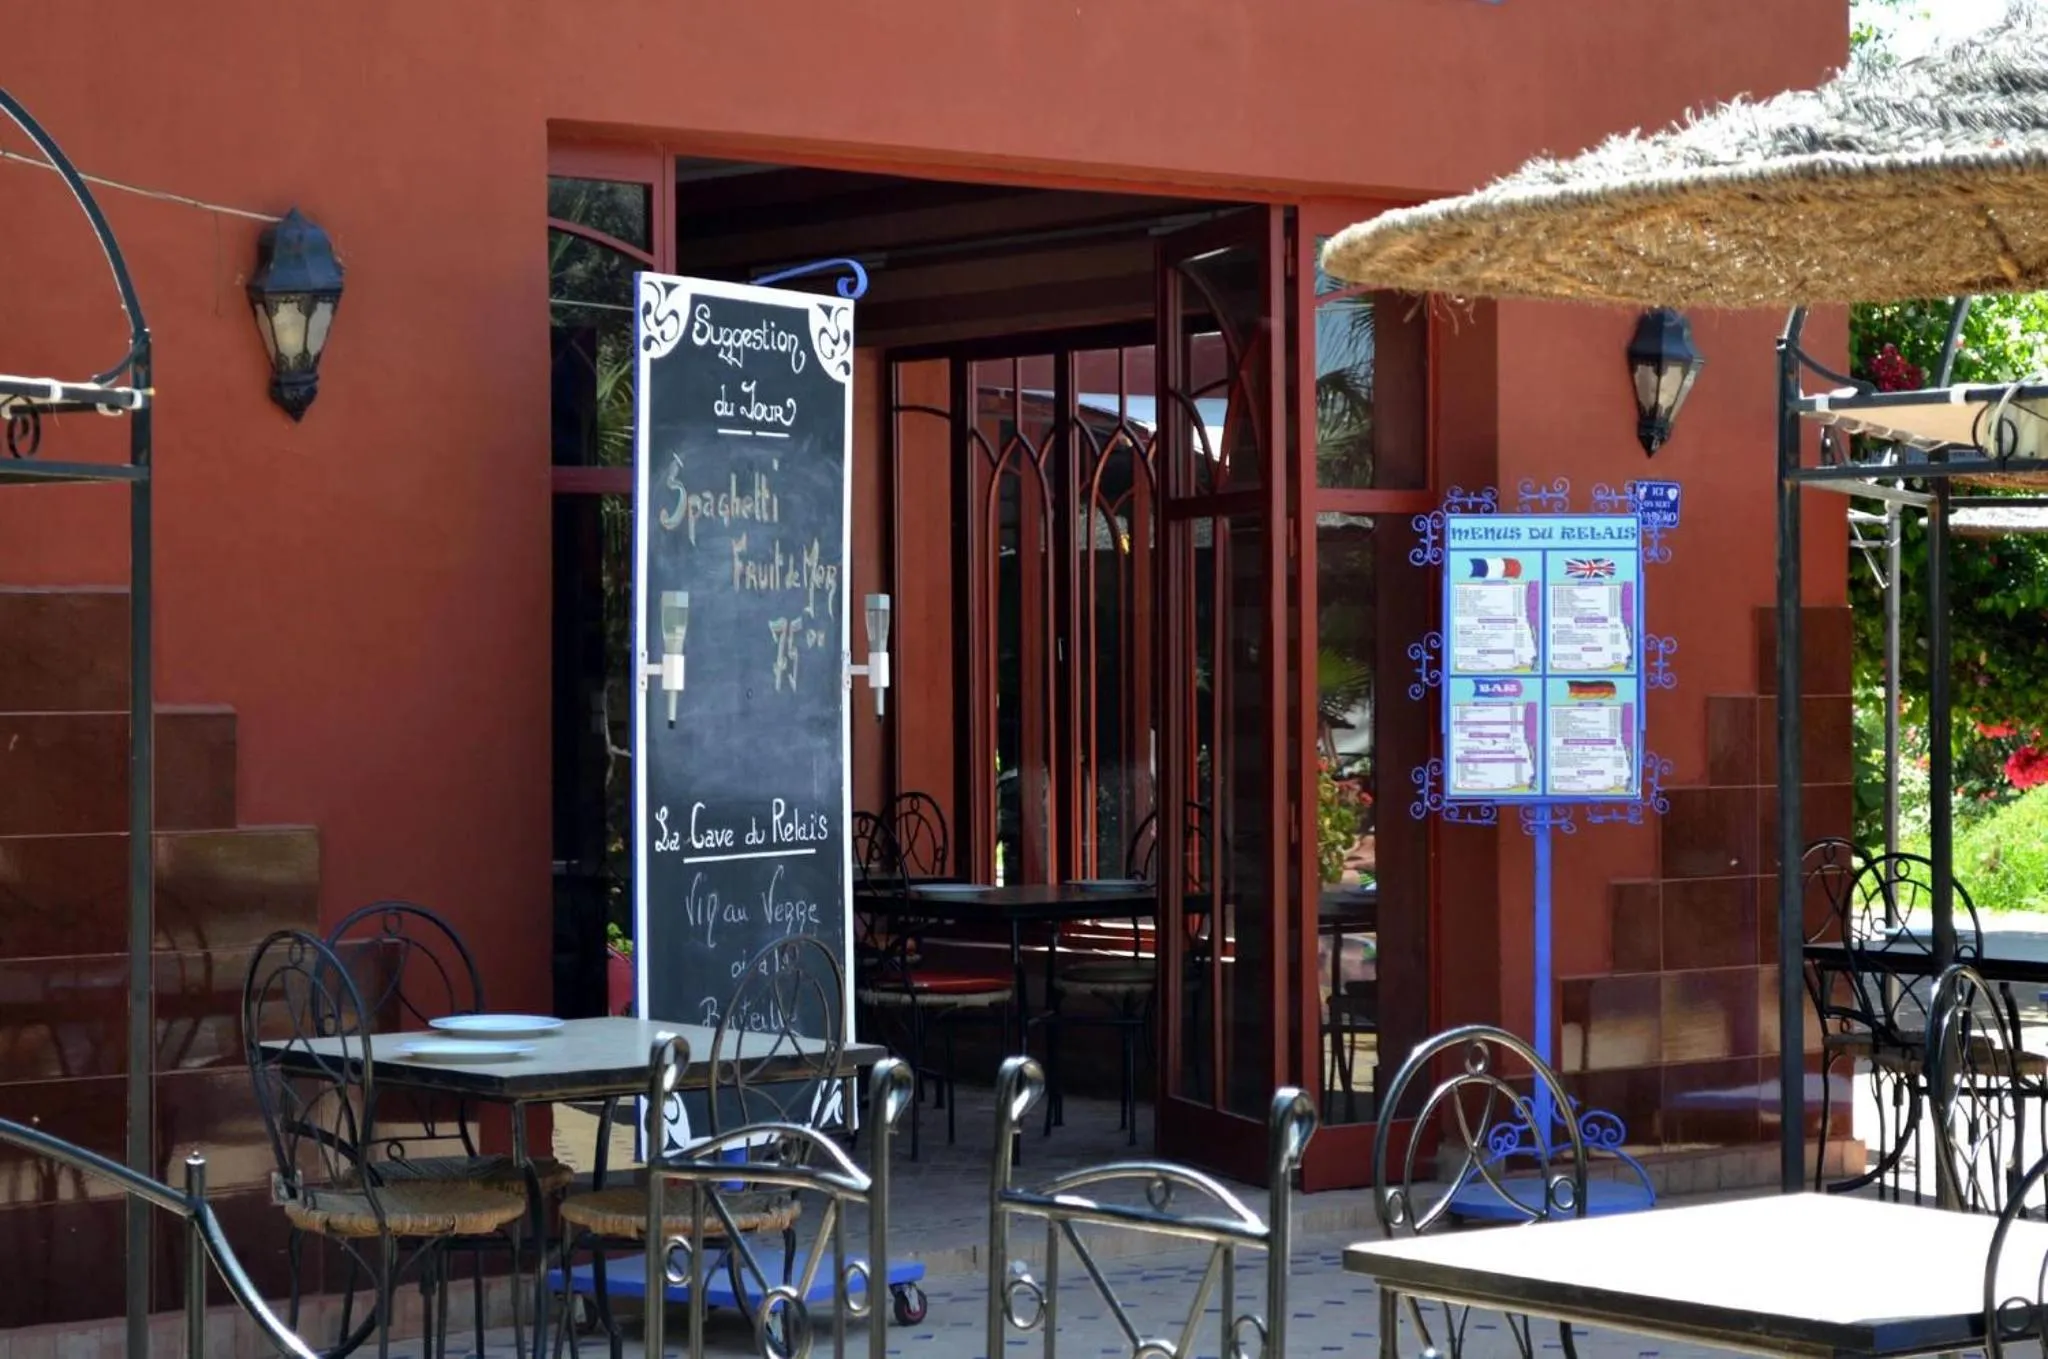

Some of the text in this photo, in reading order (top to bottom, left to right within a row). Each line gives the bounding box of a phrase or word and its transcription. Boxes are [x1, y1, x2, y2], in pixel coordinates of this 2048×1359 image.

[692, 304, 806, 374] Suggestion
[714, 384, 735, 416] du
[660, 452, 779, 546] Spaghetti
[1561, 526, 1636, 541] RELAIS
[785, 554, 801, 590] de
[768, 617, 802, 693] 75
[1479, 683, 1518, 693] BAR
[655, 798, 829, 852] La Cave du Relais
[723, 904, 749, 922] au
